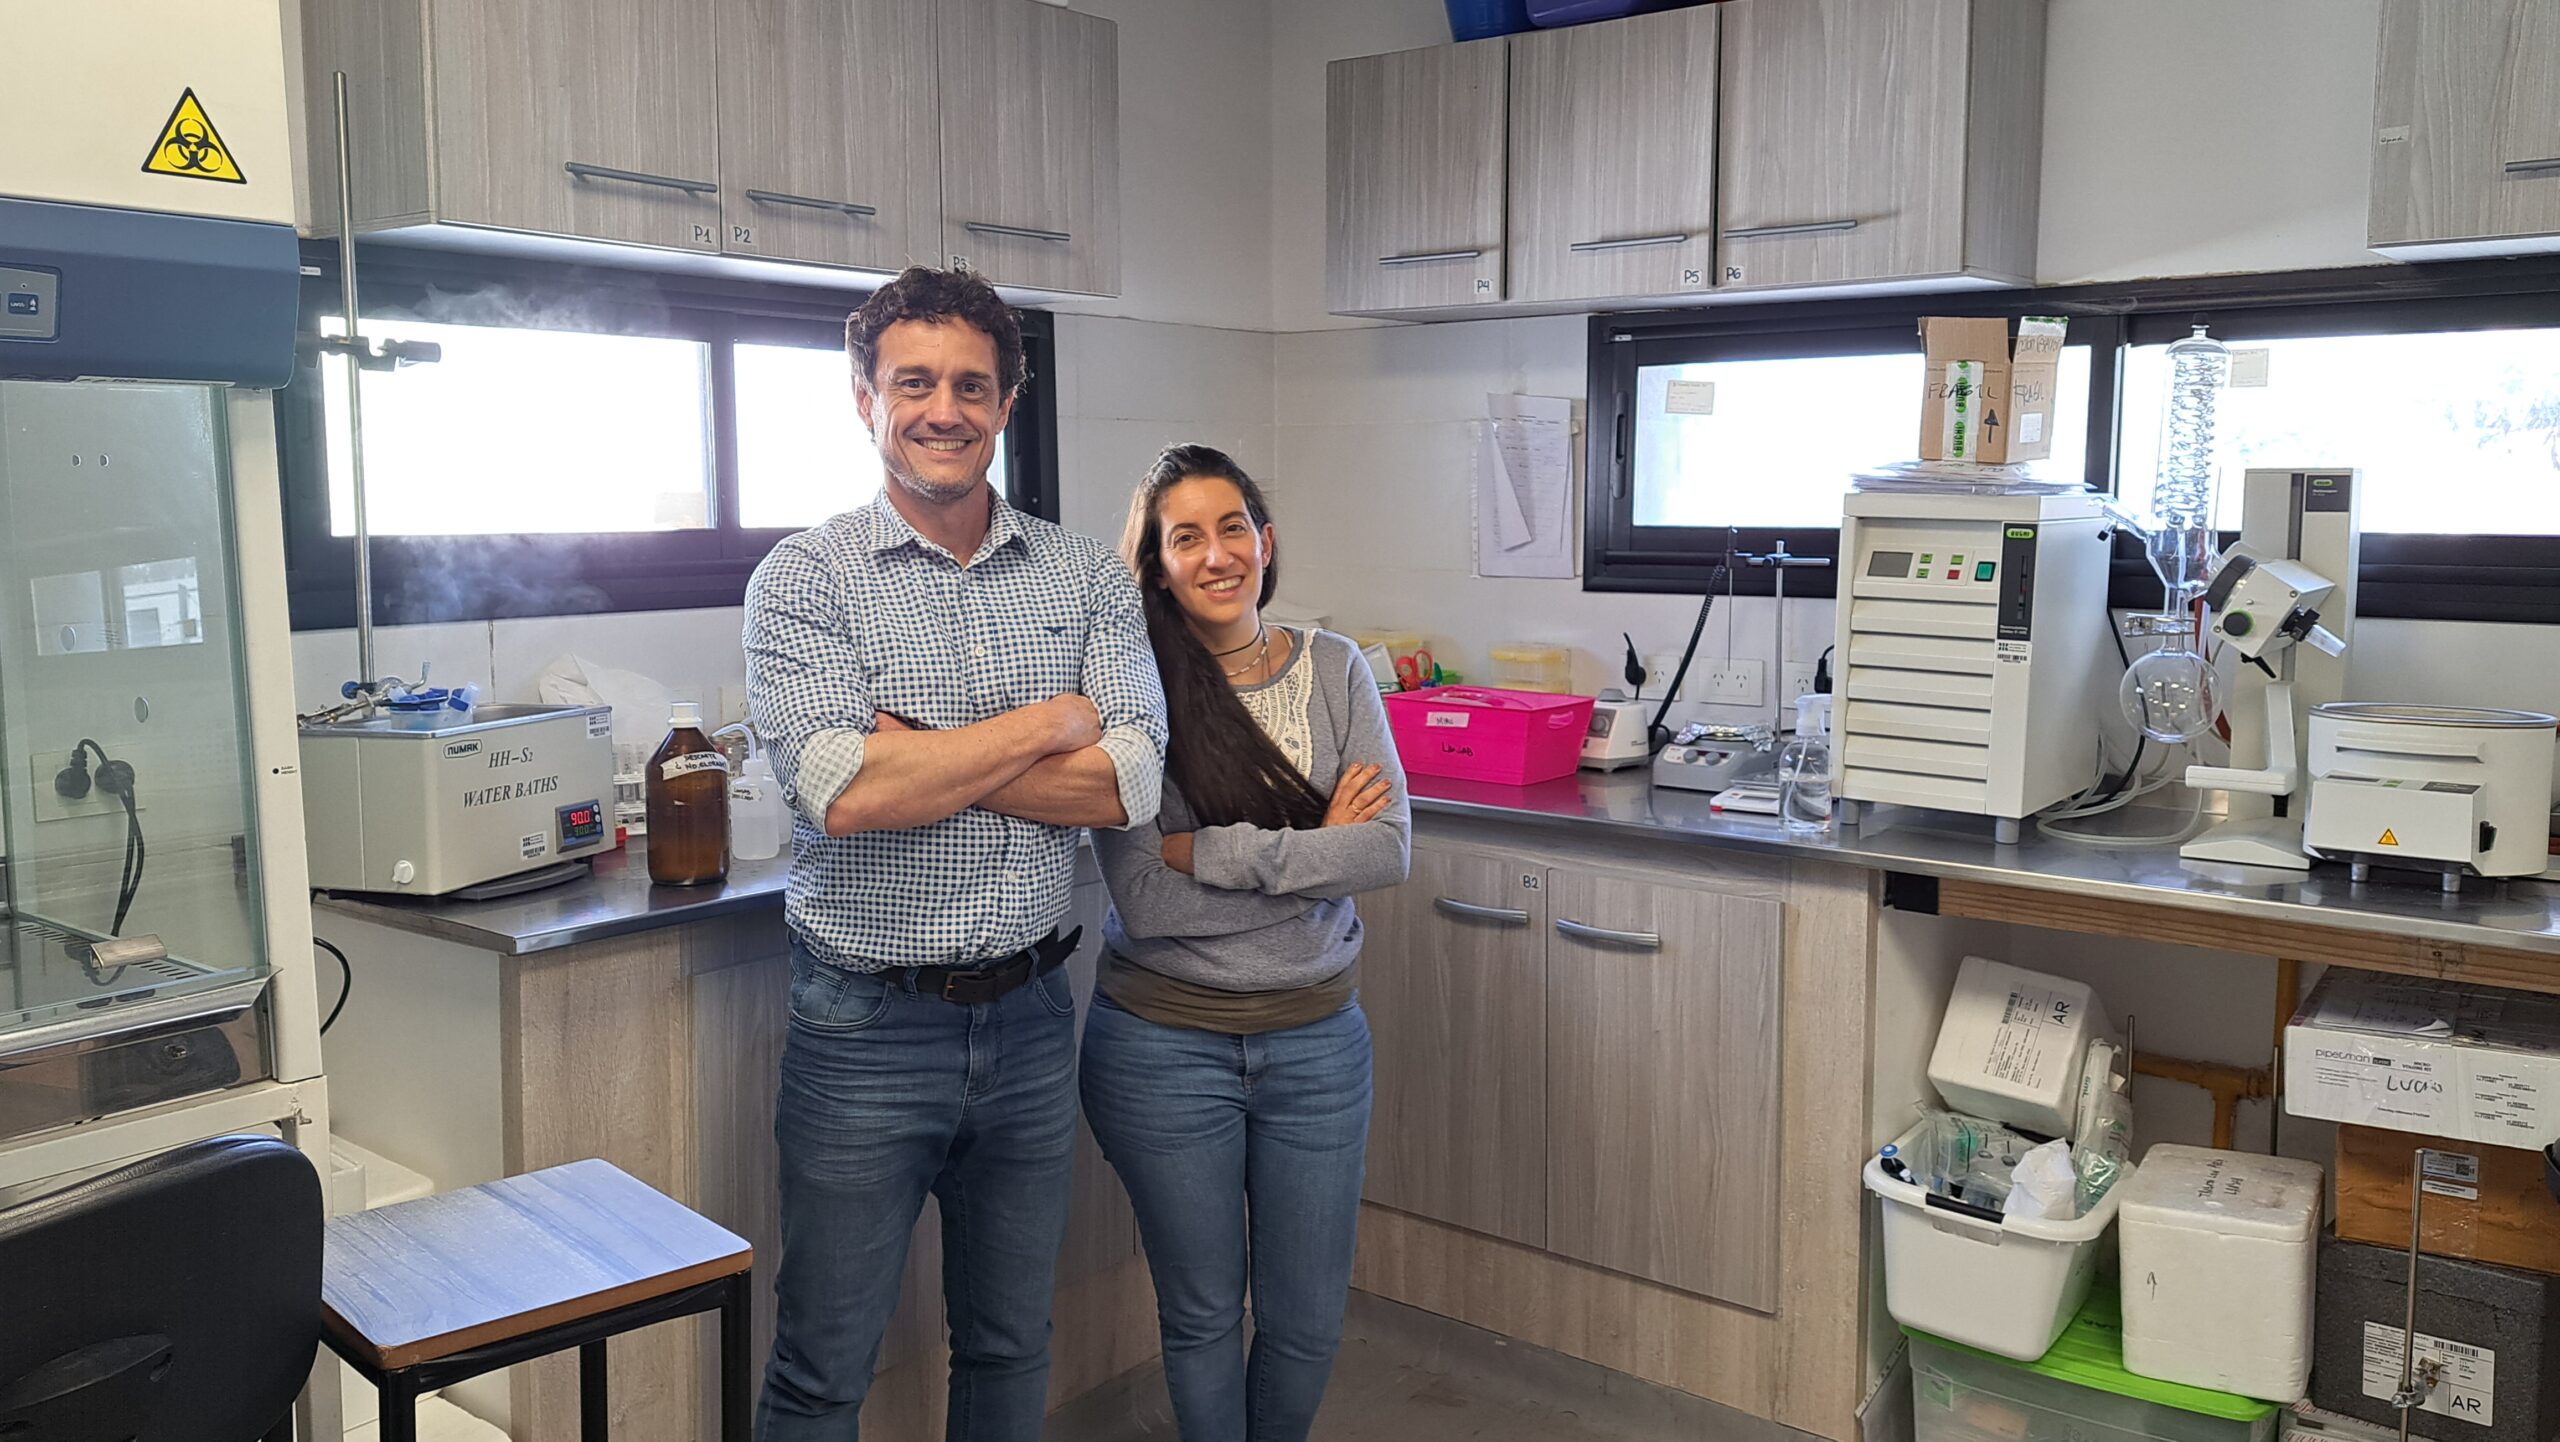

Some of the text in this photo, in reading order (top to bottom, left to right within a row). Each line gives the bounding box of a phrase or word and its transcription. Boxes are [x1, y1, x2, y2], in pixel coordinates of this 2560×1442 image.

[693, 225, 712, 244] P1
[733, 226, 752, 244] P2
[1684, 269, 1700, 284] P5
[1726, 267, 1741, 281] P6
[1476, 279, 1490, 292] P4
[463, 775, 559, 808] WATER BATHS
[1523, 875, 1539, 889] B2
[2052, 1001, 2072, 1024] AR
[2451, 1395, 2482, 1414] AR
